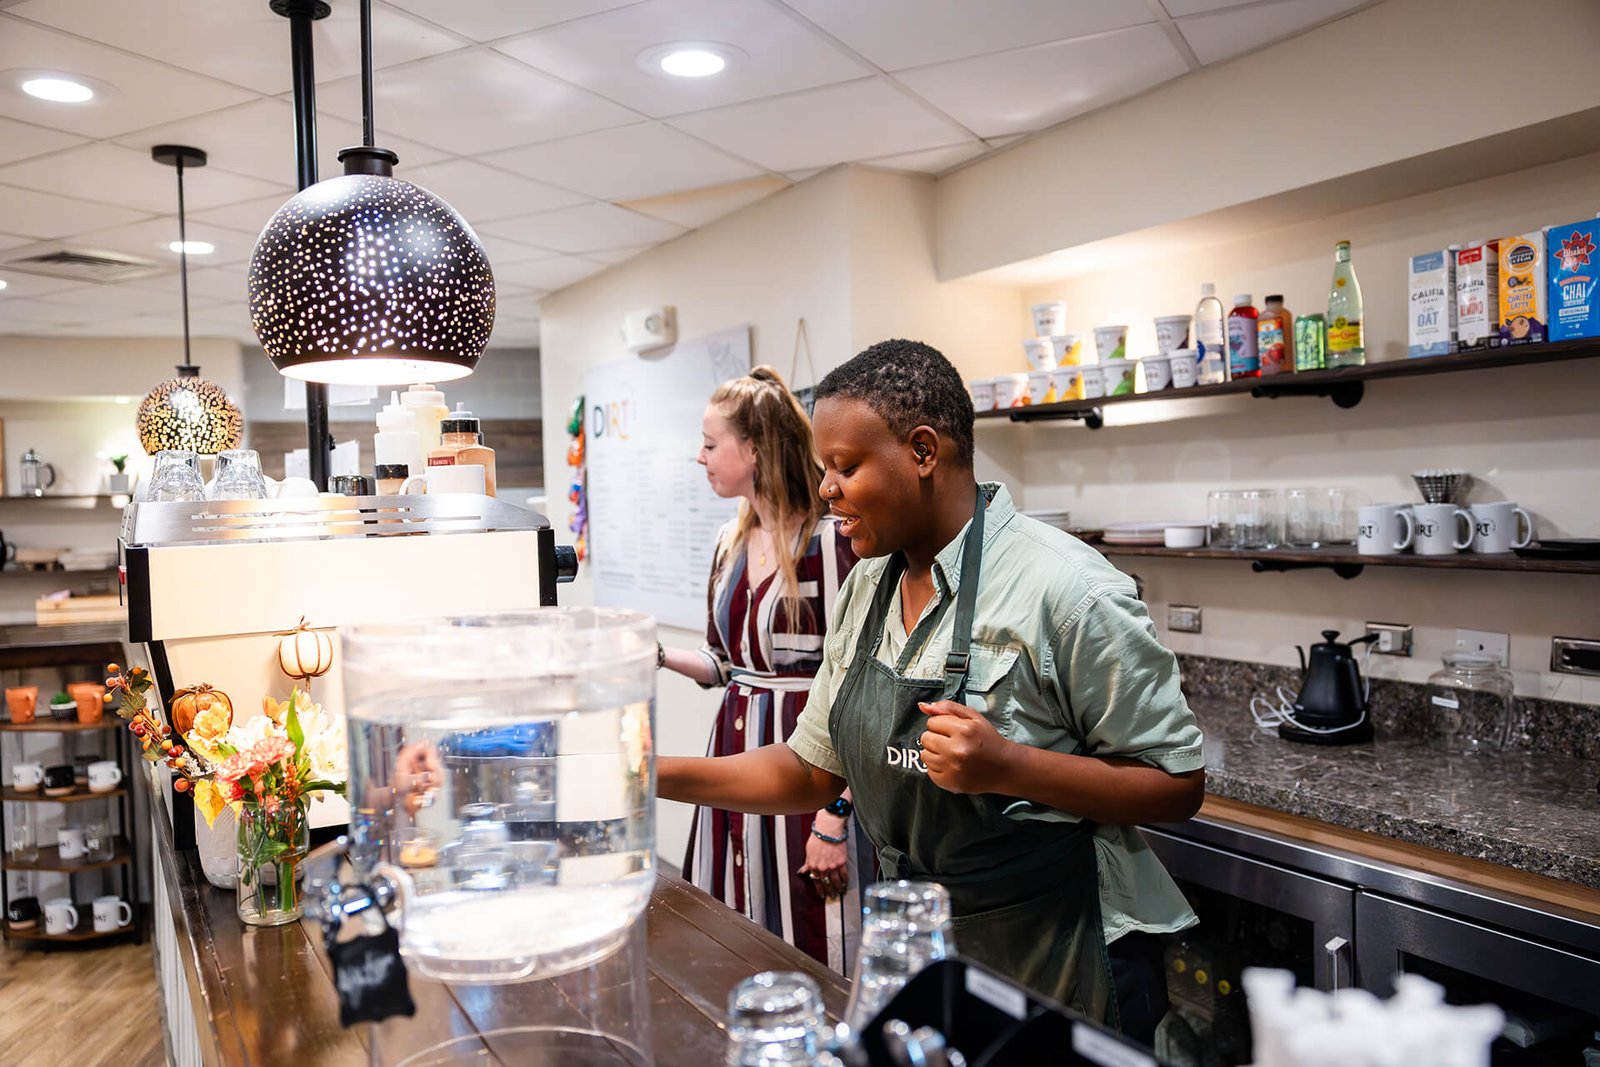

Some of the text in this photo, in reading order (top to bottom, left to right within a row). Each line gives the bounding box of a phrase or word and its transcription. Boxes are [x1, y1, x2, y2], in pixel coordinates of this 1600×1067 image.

[1411, 288, 1445, 301] CALIFIA
[1563, 282, 1586, 300] CHAI
[1417, 312, 1439, 327] OAT
[593, 400, 631, 440] DIRT
